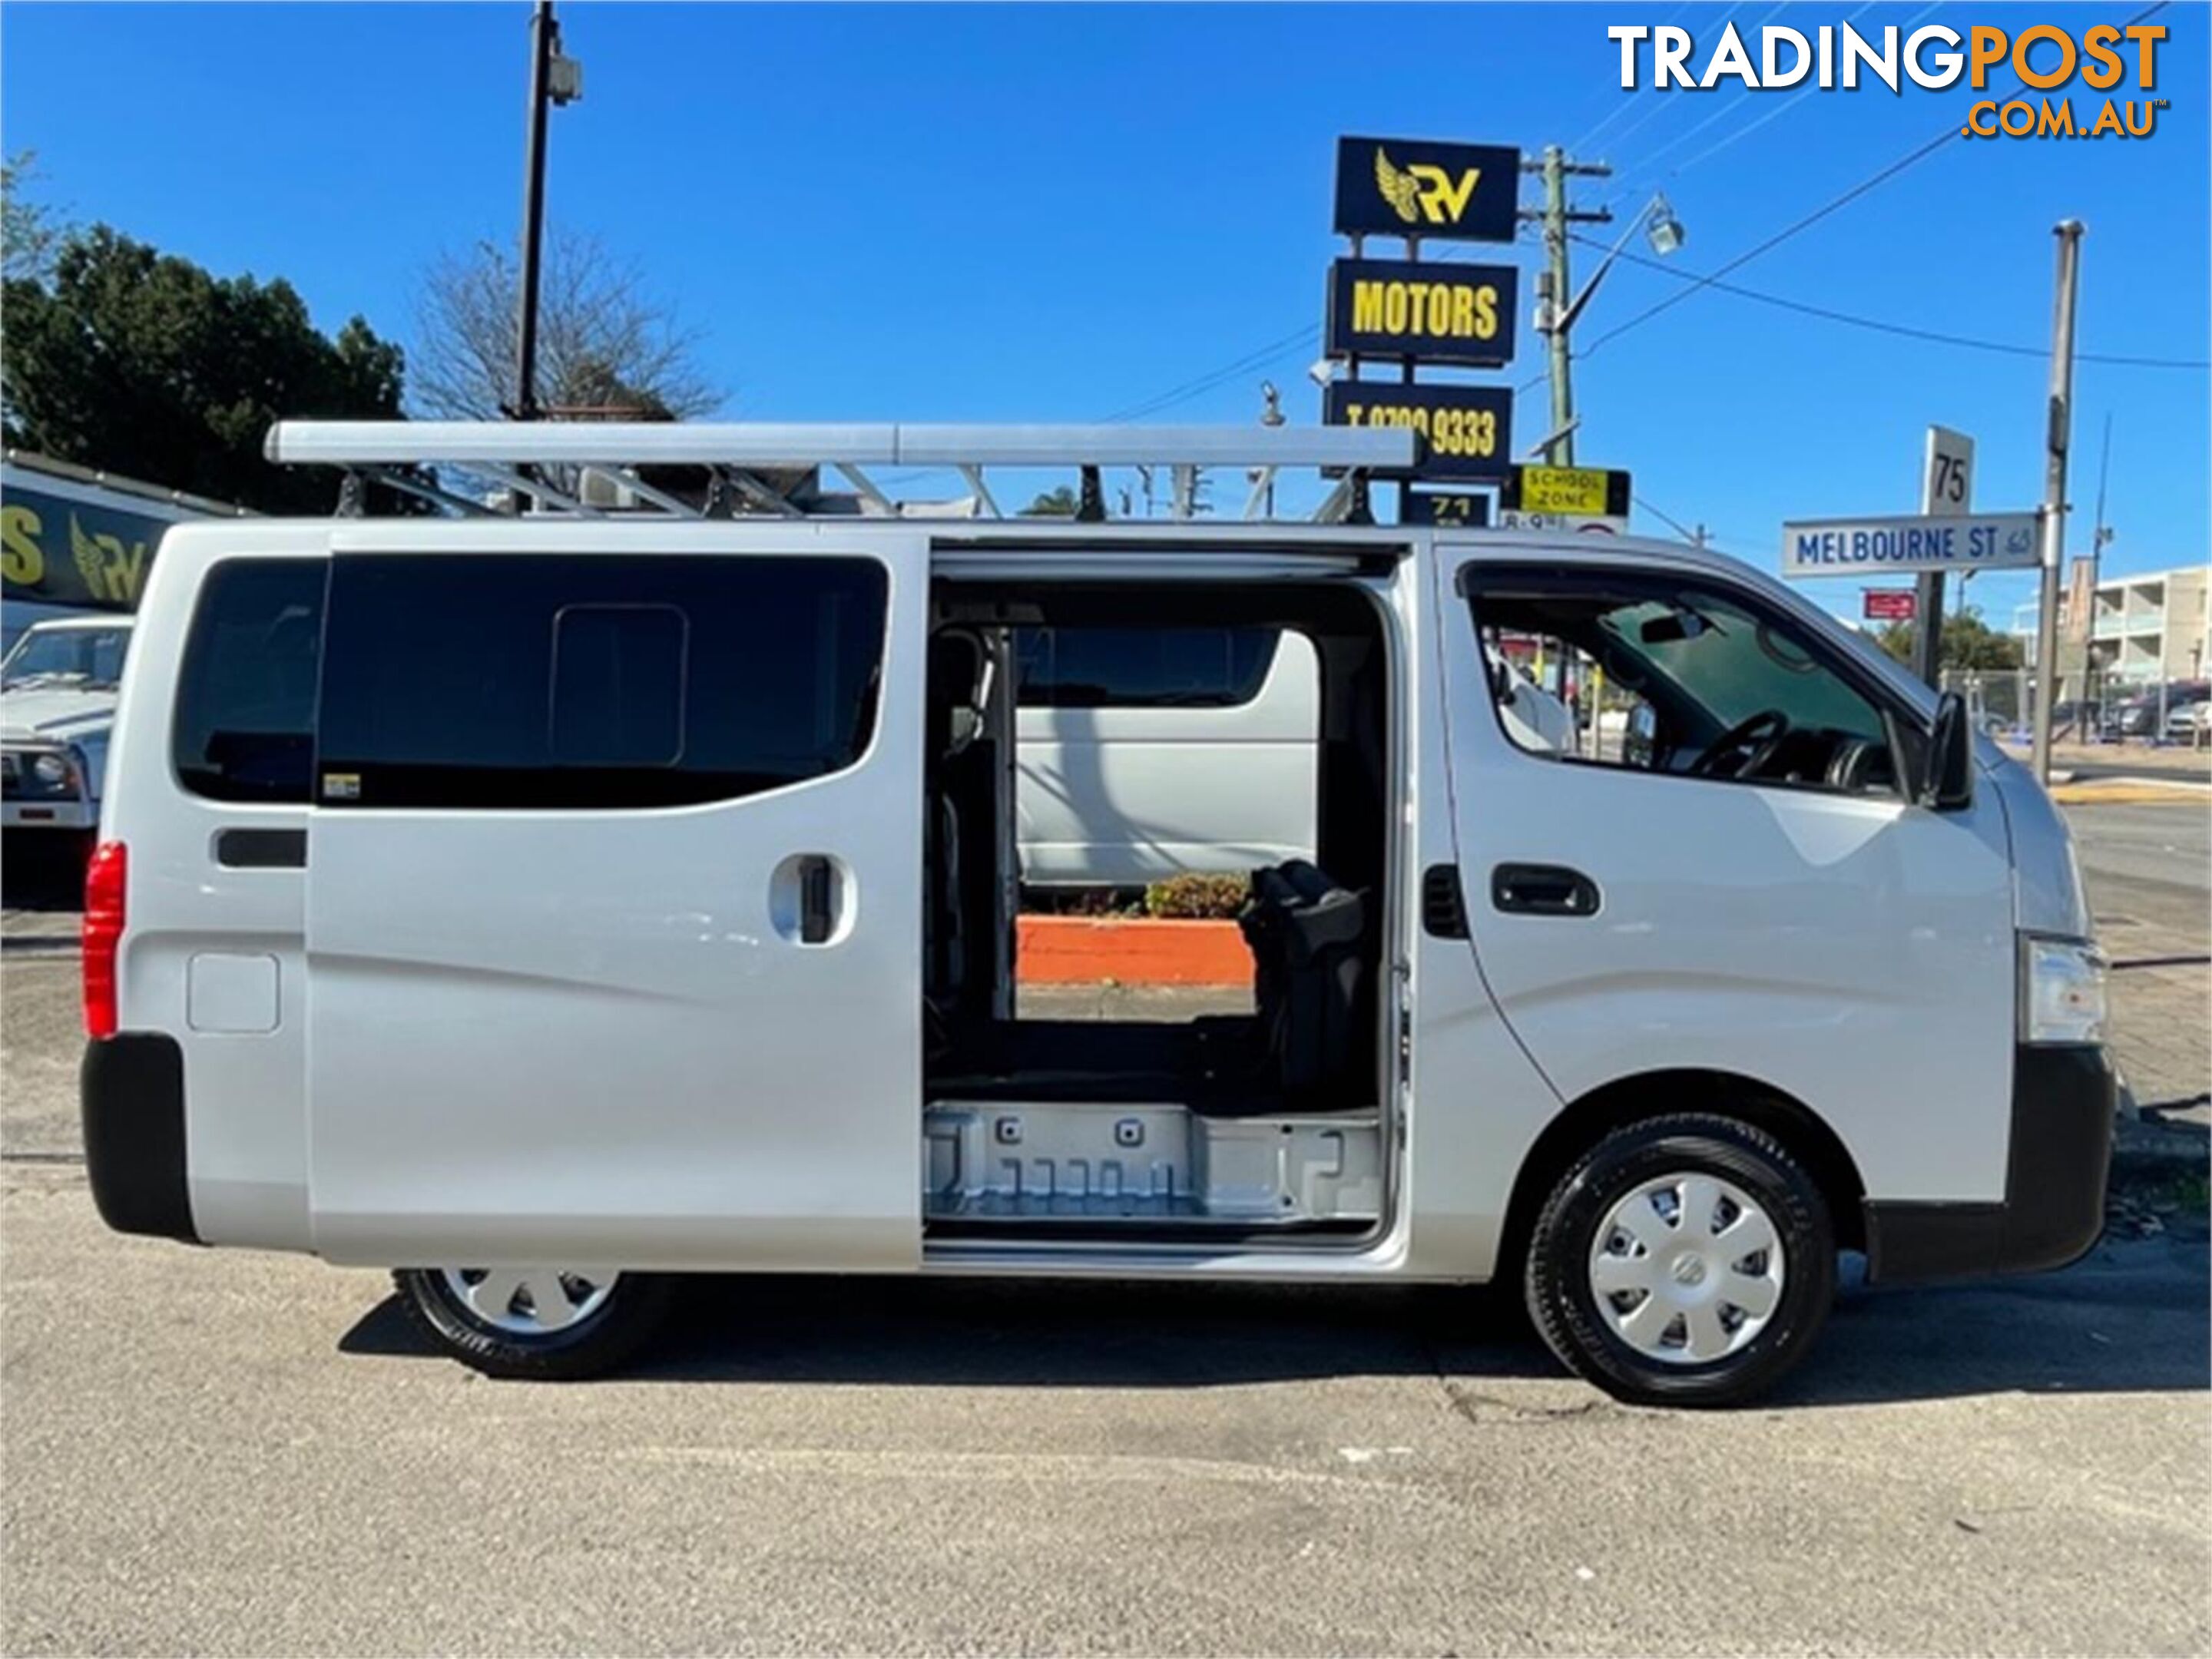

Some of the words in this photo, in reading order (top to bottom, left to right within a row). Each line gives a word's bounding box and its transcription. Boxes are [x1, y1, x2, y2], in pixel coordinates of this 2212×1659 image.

[1407, 164, 1481, 224] RV
[1353, 280, 1498, 339] MOTORS
[1432, 408, 1495, 455] 9333
[1529, 471, 1601, 491] SCHOOL
[1537, 490, 1589, 508] ZONE
[1935, 452, 1965, 503] 75
[1796, 528, 1955, 565] MELBOURNE
[1969, 526, 2000, 558] ST
